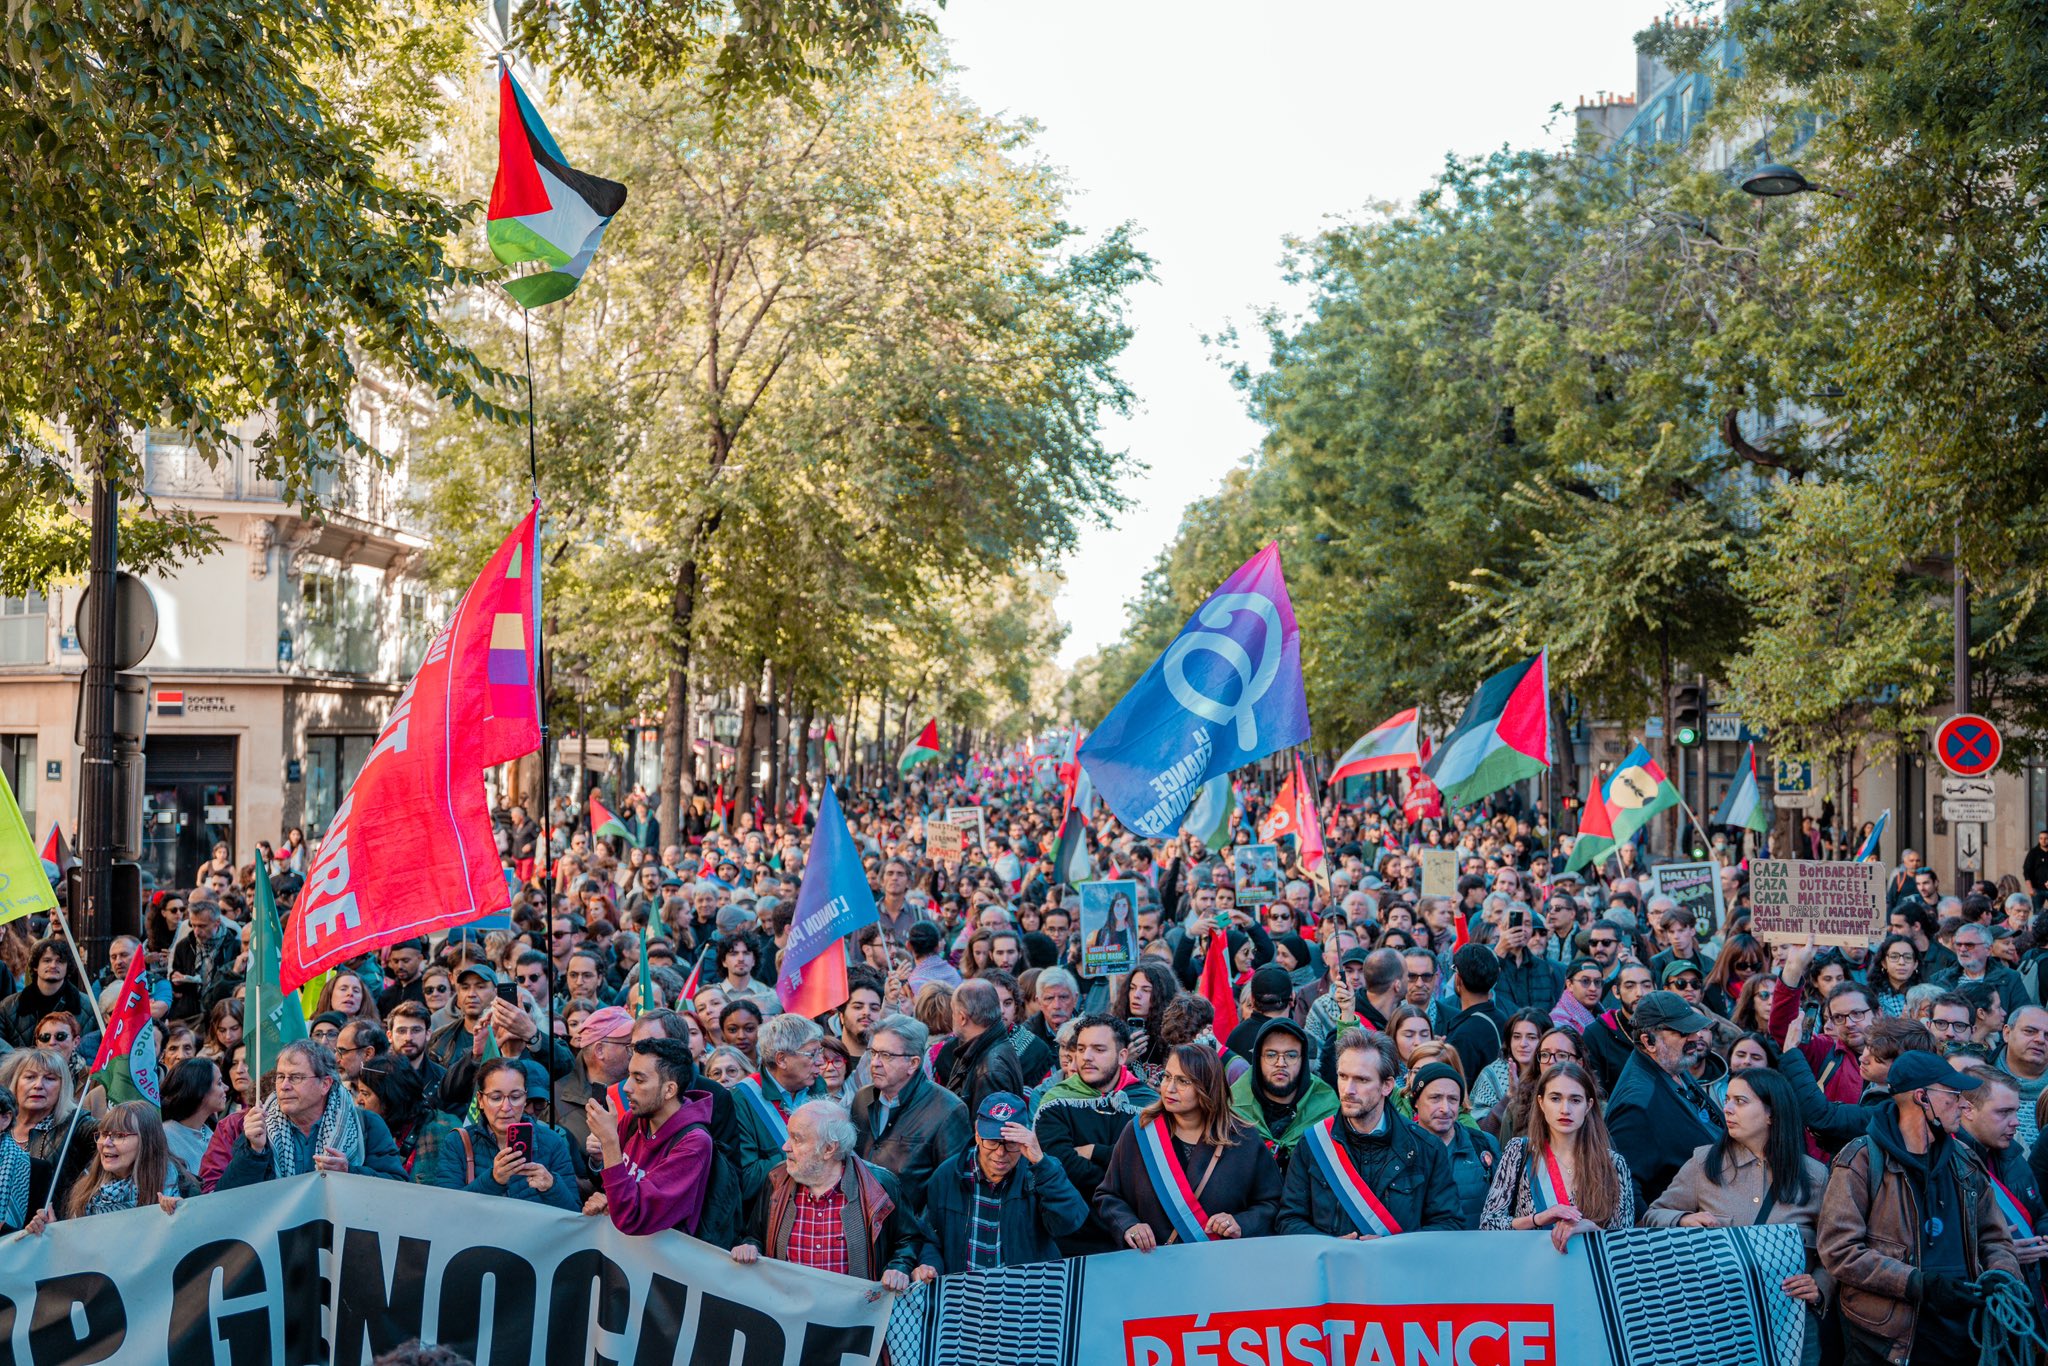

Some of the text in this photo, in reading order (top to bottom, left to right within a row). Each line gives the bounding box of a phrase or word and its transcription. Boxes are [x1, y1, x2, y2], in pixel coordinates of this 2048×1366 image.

[187, 696, 225, 704] SOCIETE
[1753, 862, 1788, 877] GAZA
[1754, 877, 1788, 890] GAZA
[1754, 891, 1789, 904] GAZA
[1789, 905, 1820, 918] PARIS
[1753, 916, 1804, 932] SOUTIENT
[0, 1271, 127, 1366] P
